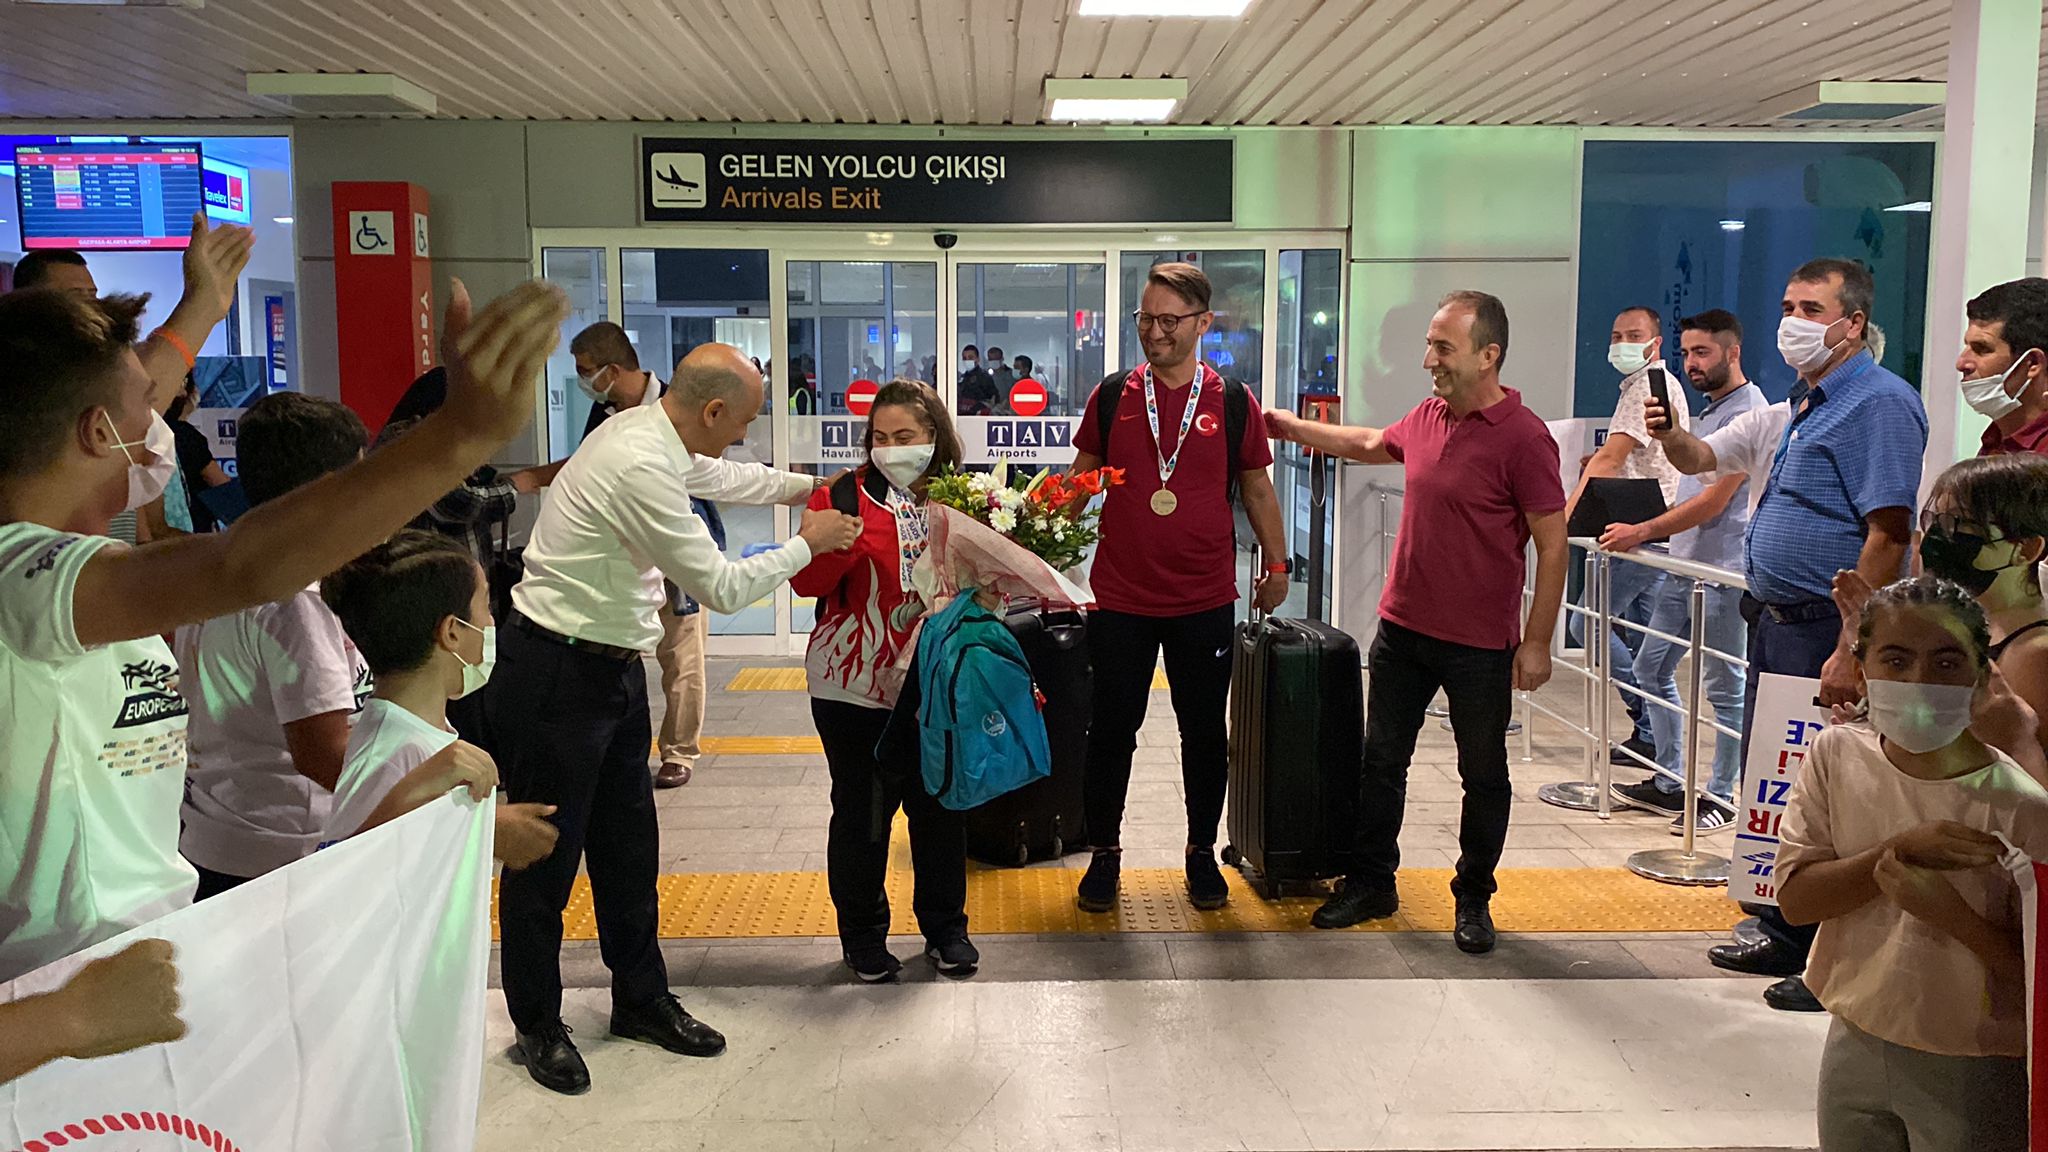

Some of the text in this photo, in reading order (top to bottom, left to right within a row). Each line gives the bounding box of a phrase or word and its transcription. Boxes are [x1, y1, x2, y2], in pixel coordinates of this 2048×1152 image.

[720, 154, 1006, 185] GELEN YOLCU ÇIKIŞI
[721, 186, 881, 209] Arrivals Exit
[420, 290, 431, 374] Yard
[988, 423, 1069, 446] TAV
[987, 448, 1037, 459] Airports
